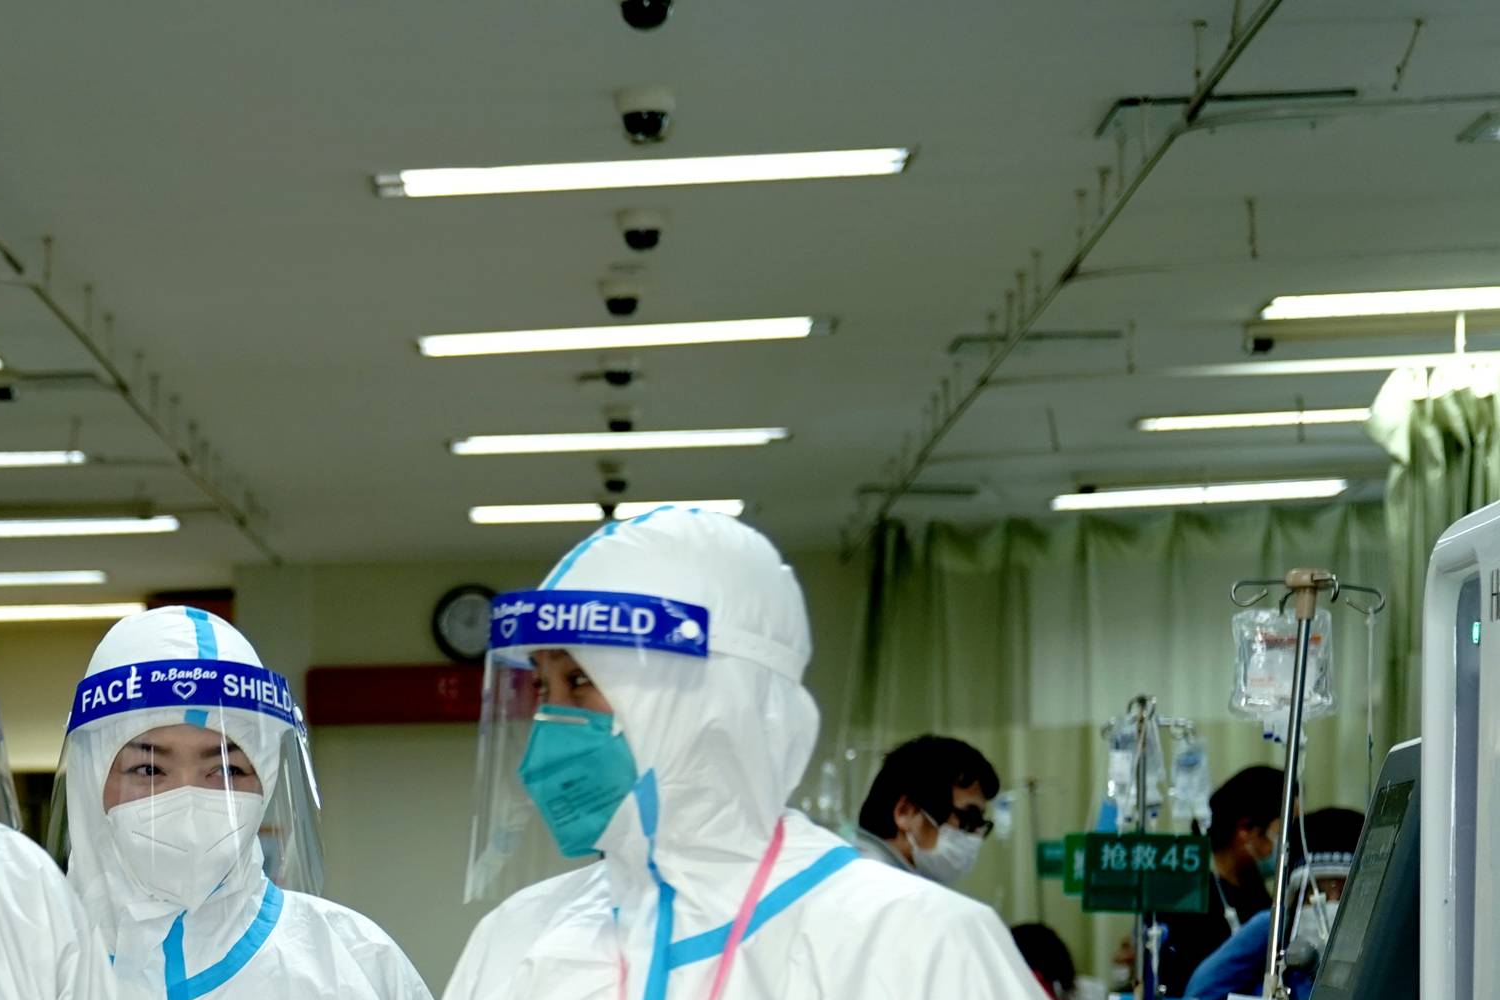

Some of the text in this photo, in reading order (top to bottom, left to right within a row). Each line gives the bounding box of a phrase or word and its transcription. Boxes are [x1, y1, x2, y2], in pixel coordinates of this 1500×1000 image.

[536, 603, 657, 635] SHIELD
[150, 667, 218, 683] Dr.BanBao
[81, 673, 292, 713] FACE SHIELD
[1101, 842, 1202, 872] 抢救45
